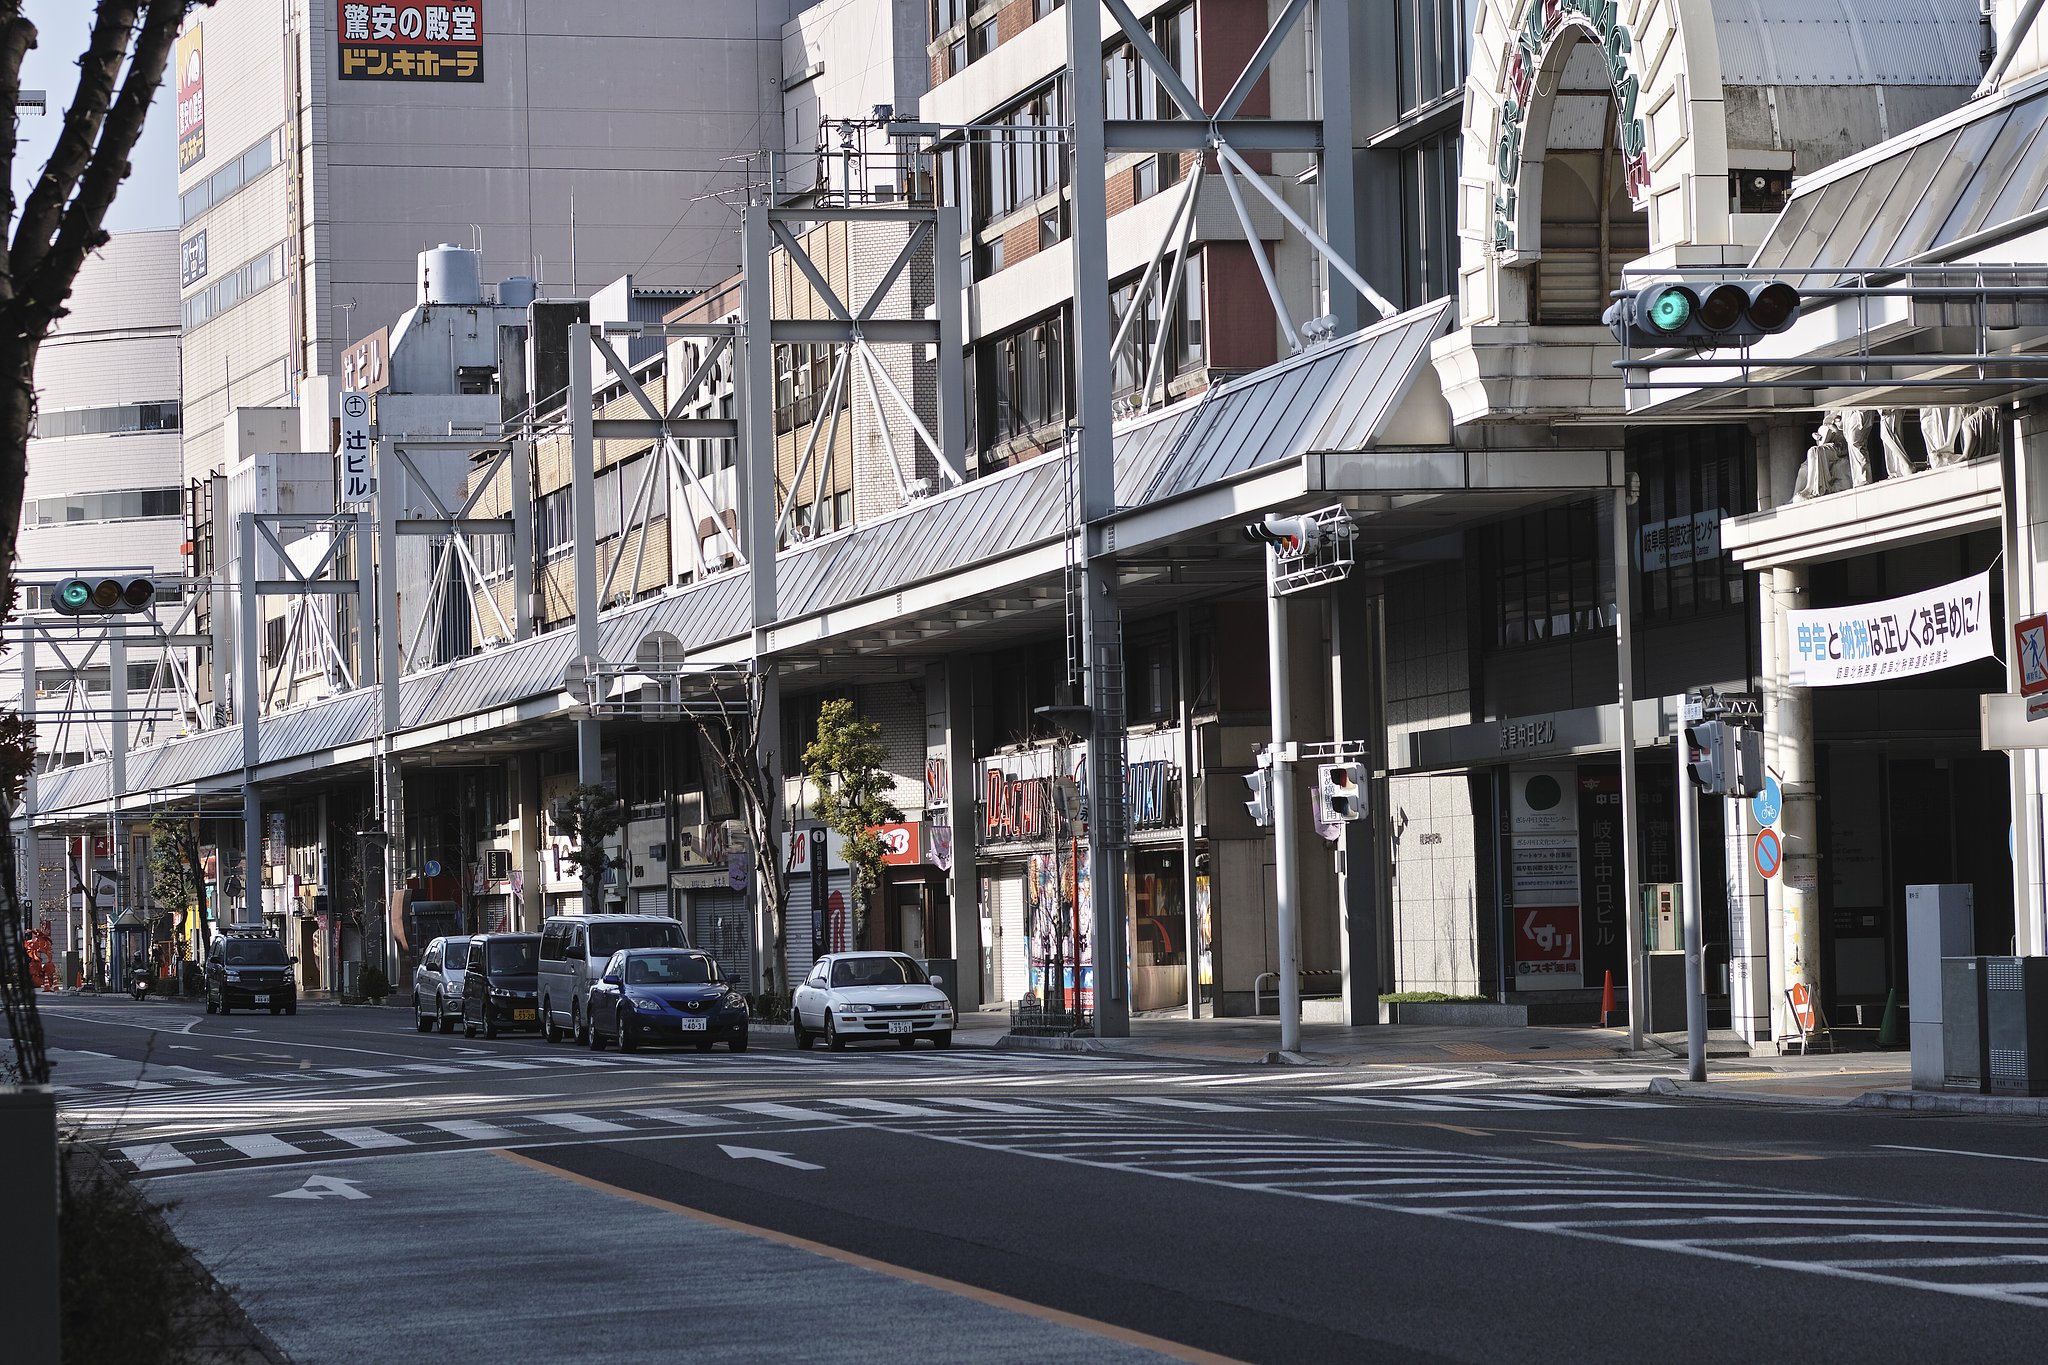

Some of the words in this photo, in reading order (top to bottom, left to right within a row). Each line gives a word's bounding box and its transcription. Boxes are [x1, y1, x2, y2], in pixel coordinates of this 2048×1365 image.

[345, 5, 476, 41] 驚安の殿堂
[346, 430, 367, 496] 辻ビル
[1797, 591, 1981, 661] 申告と納税は正しくお早めに!
[1500, 720, 1555, 750] 岐阜中日ビル
[1592, 819, 1615, 946] 岐阜中日ビル
[1523, 911, 1572, 957] くすり
[1531, 962, 1577, 973] スギ薬局
[687, 1022, 705, 1030] 40-31
[893, 1025, 911, 1033] 33-01
